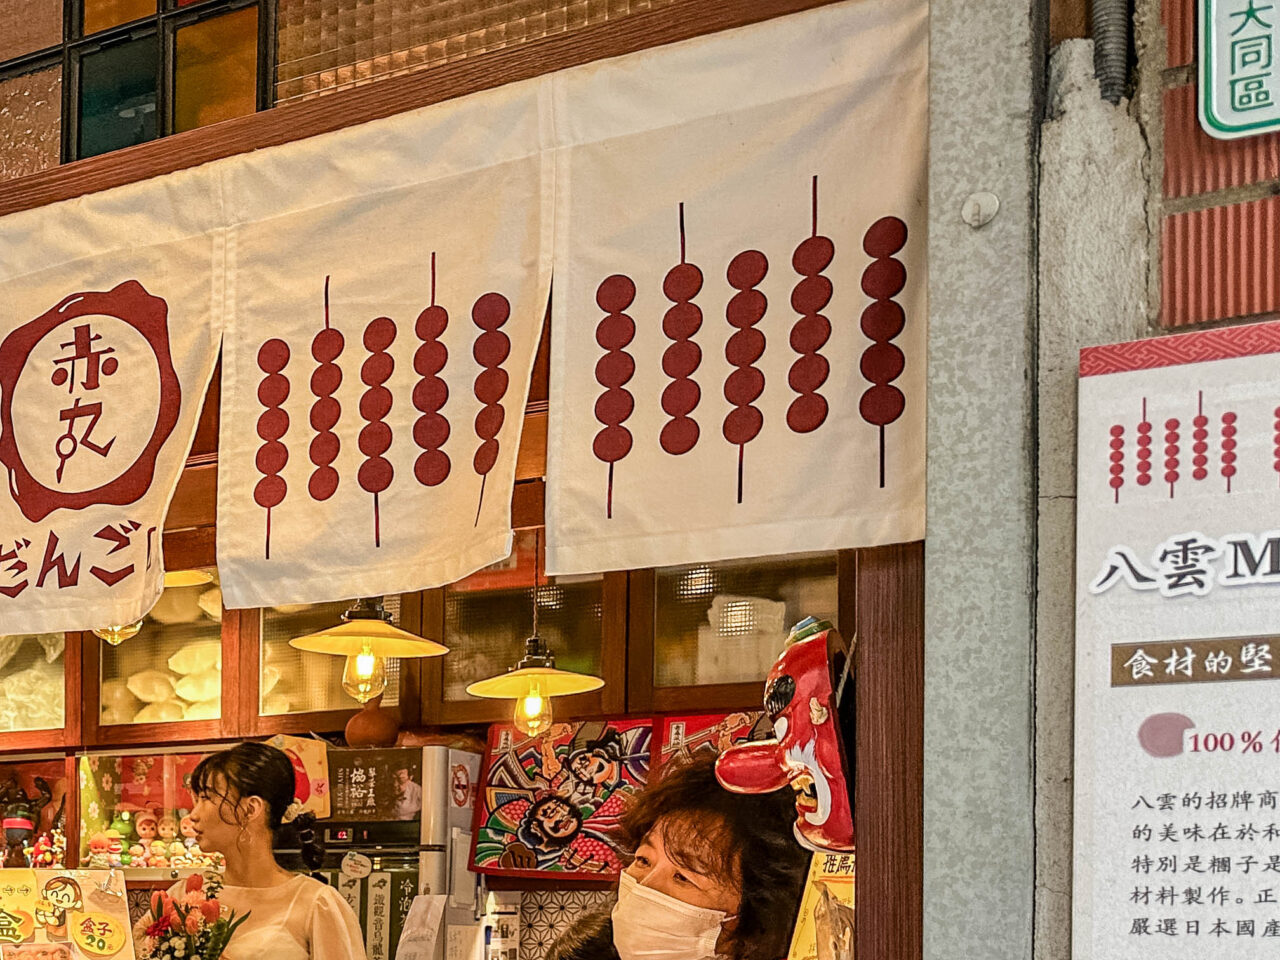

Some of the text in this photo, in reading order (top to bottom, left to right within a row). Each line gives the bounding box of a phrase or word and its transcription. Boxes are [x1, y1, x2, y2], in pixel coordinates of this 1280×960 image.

[1228, 0, 1274, 112] 大同區
[1097, 538, 1216, 590] 八雲
[1123, 643, 1272, 679] 食材的堅
[1131, 790, 1279, 811] 八雲的招牌商
[1132, 822, 1280, 842] 的美味在於和
[1131, 854, 1280, 874] 特別是糰子是
[1130, 886, 1278, 906] 材料製作。正
[80, 917, 112, 936] 盒子
[1129, 917, 1280, 938] 嚴選日本國產
